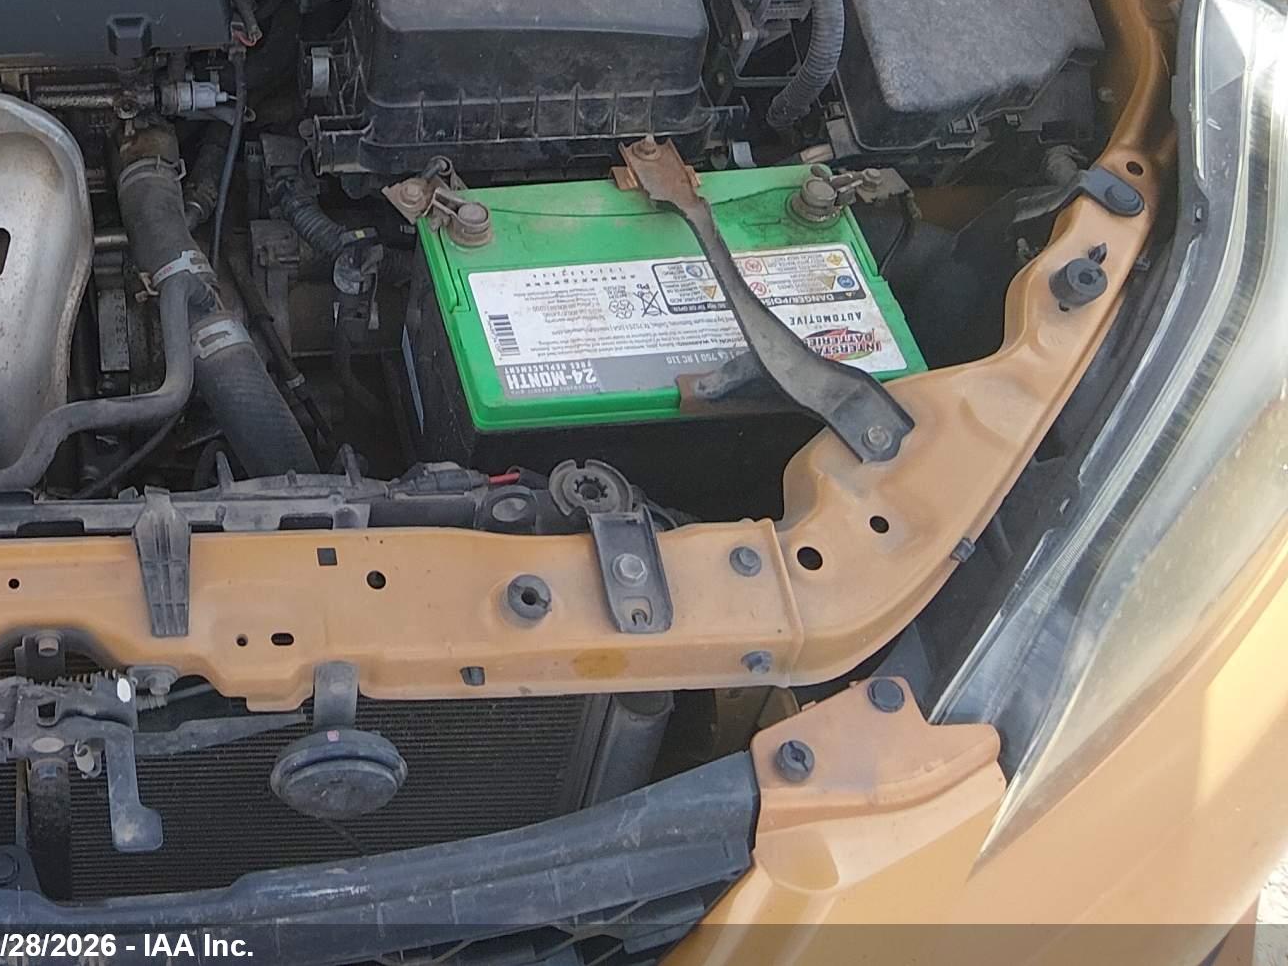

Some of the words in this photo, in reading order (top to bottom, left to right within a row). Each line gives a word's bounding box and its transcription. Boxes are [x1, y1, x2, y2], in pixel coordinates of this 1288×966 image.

[761, 293, 834, 307] DANGER/POIS
[789, 311, 862, 326] AUTOMOTIVE
[812, 339, 882, 359] INTERSTA
[506, 368, 597, 389] 24-MONTH
